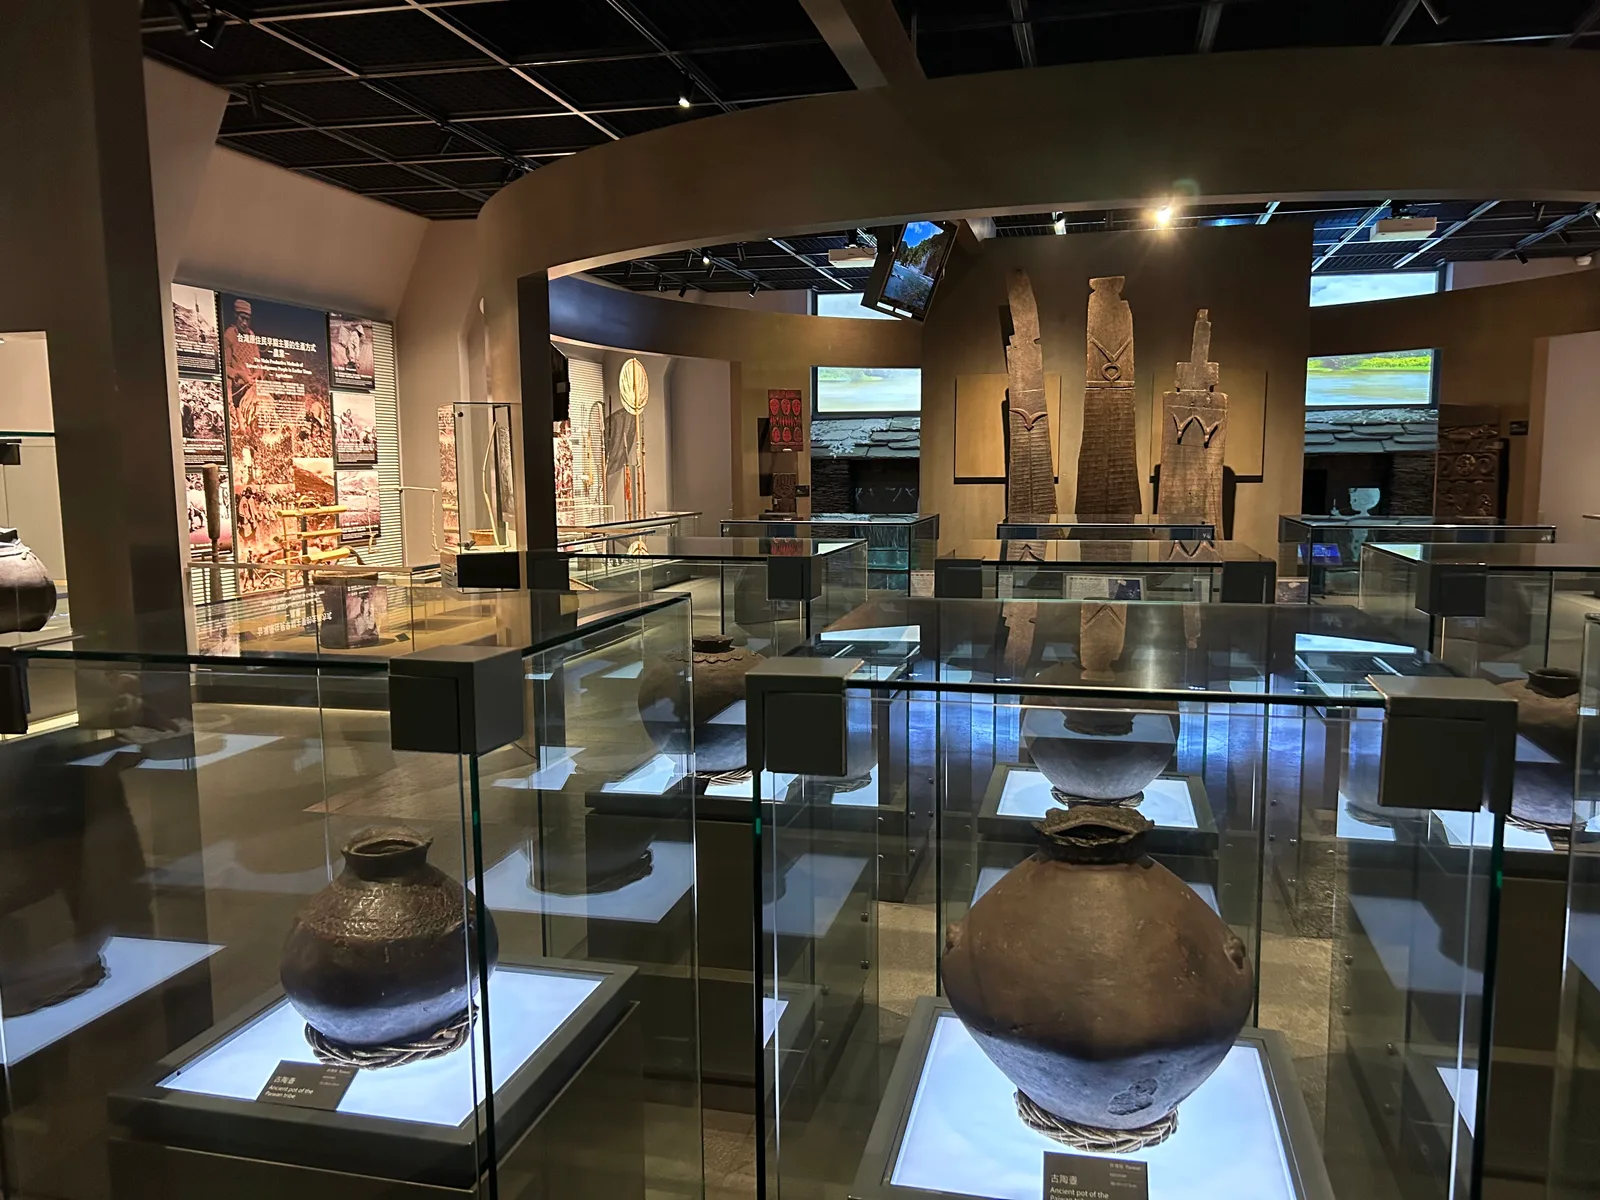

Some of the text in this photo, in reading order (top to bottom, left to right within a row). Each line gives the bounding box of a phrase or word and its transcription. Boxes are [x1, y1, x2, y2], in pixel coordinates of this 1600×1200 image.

[1050, 1174, 1078, 1185] 古陶壺
[1050, 1187, 1075, 1195] Ancient
[1097, 1191, 1109, 1199] the
